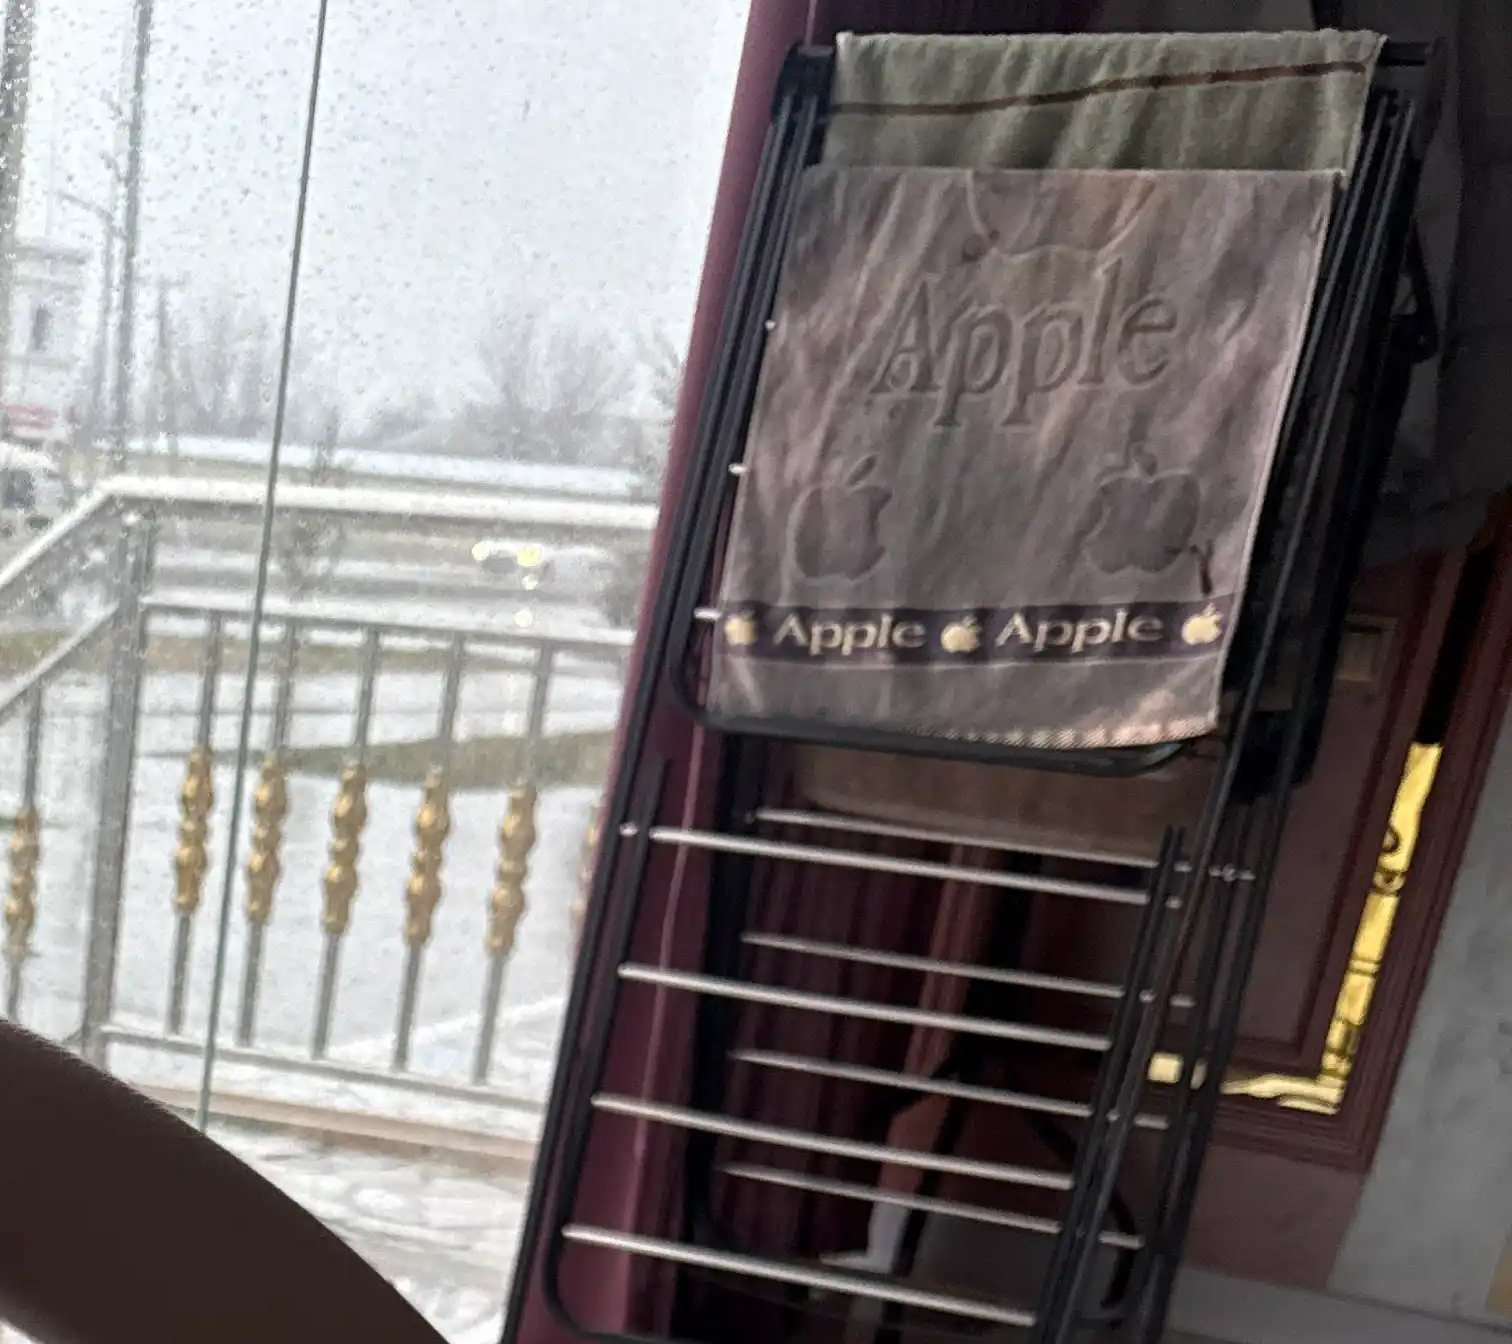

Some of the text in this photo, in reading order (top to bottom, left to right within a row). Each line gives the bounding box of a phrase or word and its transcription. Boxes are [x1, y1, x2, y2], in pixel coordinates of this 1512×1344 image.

[869, 251, 1180, 428] Apple
[774, 609, 1164, 656] Apple Apple
